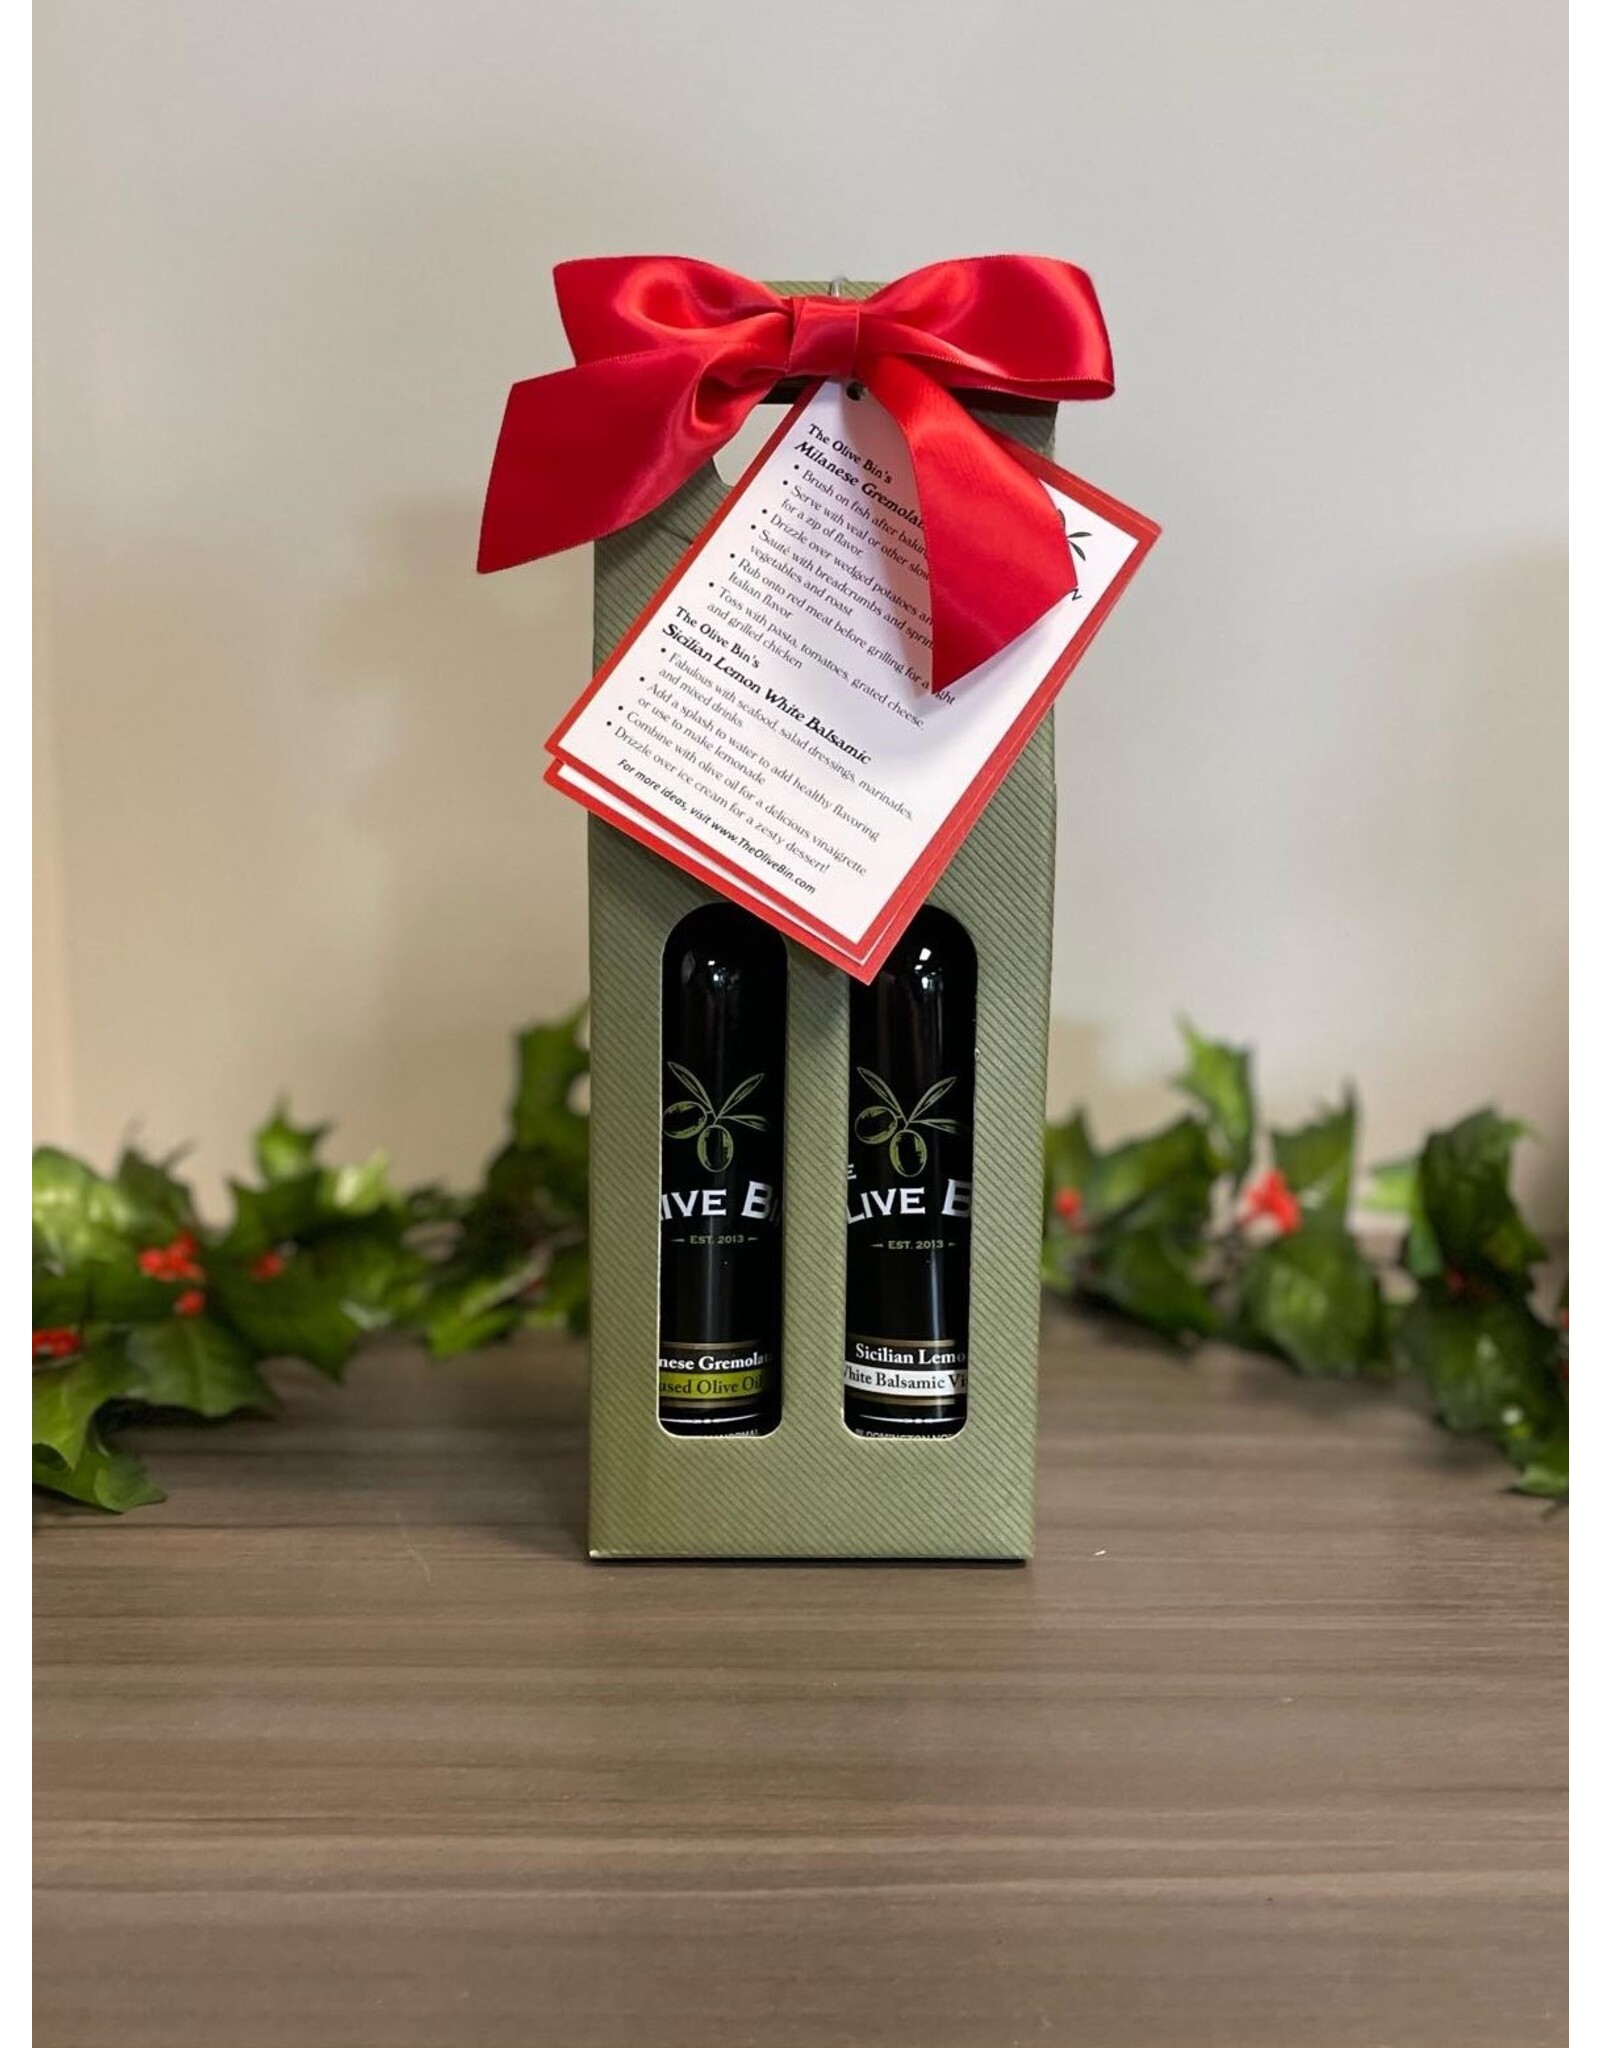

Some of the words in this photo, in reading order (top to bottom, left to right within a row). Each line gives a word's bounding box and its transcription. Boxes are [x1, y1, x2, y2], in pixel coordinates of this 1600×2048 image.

[794, 441, 859, 485] Milanese
[808, 423, 830, 444] The
[831, 439, 861, 463] Olive
[862, 458, 892, 484] Bin's
[780, 498, 798, 514] for
[796, 511, 805, 520] a
[804, 516, 822, 530] zip
[822, 527, 837, 538] of
[790, 484, 822, 511] Serve
[823, 507, 844, 526] with
[846, 522, 869, 540] veal
[867, 536, 881, 548] or
[880, 545, 909, 565] other
[801, 469, 834, 497] Brush
[834, 493, 850, 507] on
[850, 500, 871, 520] fish
[871, 517, 899, 536] after
[728, 571, 761, 599] Italian
[750, 544, 802, 583] vegetables
[803, 581, 827, 598] and
[824, 594, 853, 616] roast
[758, 529, 791, 555] Sauté
[791, 552, 814, 572] with
[814, 565, 882, 616] breadcrumbs
[882, 613, 907, 630] and
[769, 513, 808, 544] Drizzle
[808, 541, 833, 559] over
[833, 556, 875, 586] wedged
[871, 582, 917, 615] potatoes
[675, 605, 697, 627] The
[699, 623, 729, 647] Olive
[729, 642, 760, 668] Bin's
[706, 604, 731, 620] and
[727, 617, 765, 642] grilled
[762, 639, 803, 669] chicken
[718, 586, 743, 610] Toss
[745, 607, 767, 627] with
[850, 678, 889, 704] grated
[737, 557, 761, 579] Rub
[761, 576, 786, 595] onto
[785, 592, 807, 608] red
[804, 604, 834, 626] meat
[833, 620, 867, 648] before
[866, 645, 905, 674] grilling
[904, 666, 922, 682] for
[920, 680, 930, 690] a
[658, 669, 682, 685] and
[679, 682, 713, 706] mixed
[711, 701, 743, 727] drinks
[662, 623, 713, 662] Sicilian
[713, 656, 761, 694] Lemon
[764, 687, 805, 721] White
[804, 716, 871, 764] Balsamic
[668, 651, 713, 688] Fabulous
[714, 684, 736, 704] with
[778, 728, 810, 750] salad
[637, 697, 652, 709] or
[651, 706, 671, 722] use
[671, 718, 683, 730] to
[682, 727, 713, 751] make
[713, 744, 766, 785] lemonade
[646, 683, 673, 703] Add
[670, 700, 679, 709] a
[680, 705, 714, 732] splash
[714, 727, 727, 739] to
[728, 736, 758, 759] water
[758, 756, 770, 768] to
[770, 766, 794, 783] add
[792, 776, 833, 809] healthy
[832, 803, 880, 842] flavoring
[614, 725, 652, 757] Drizzle
[652, 754, 678, 772] over
[676, 768, 694, 784] ice
[693, 782, 728, 808] cream
[728, 801, 746, 818] for
[745, 816, 754, 825] a
[754, 822, 785, 845] zesty
[785, 841, 830, 873] dessert!
[617, 758, 636, 773] For
[634, 770, 661, 791] more
[660, 787, 687, 811] ideas,
[689, 807, 712, 824] visit
[710, 821, 816, 894] www.TheOliveBin.com
[626, 710, 673, 747] Combine
[674, 744, 697, 764] with
[697, 760, 723, 780] olive
[723, 777, 740, 791] oil
[737, 784, 756, 800] for
[754, 798, 763, 808] a
[764, 804, 809, 838] delicious
[812, 835, 867, 876] vinaigrette
[660, 1189, 727, 1221] IVE
[690, 1235, 715, 1245] EST.
[717, 1234, 744, 1244] 2013
[888, 1240, 913, 1250] EST.
[915, 1239, 944, 1249] 2013
[697, 1379, 739, 1395] Olive
[742, 1375, 762, 1392] Oil
[855, 1343, 914, 1365] Sicilian
[875, 1371, 945, 1389] Balsamic
